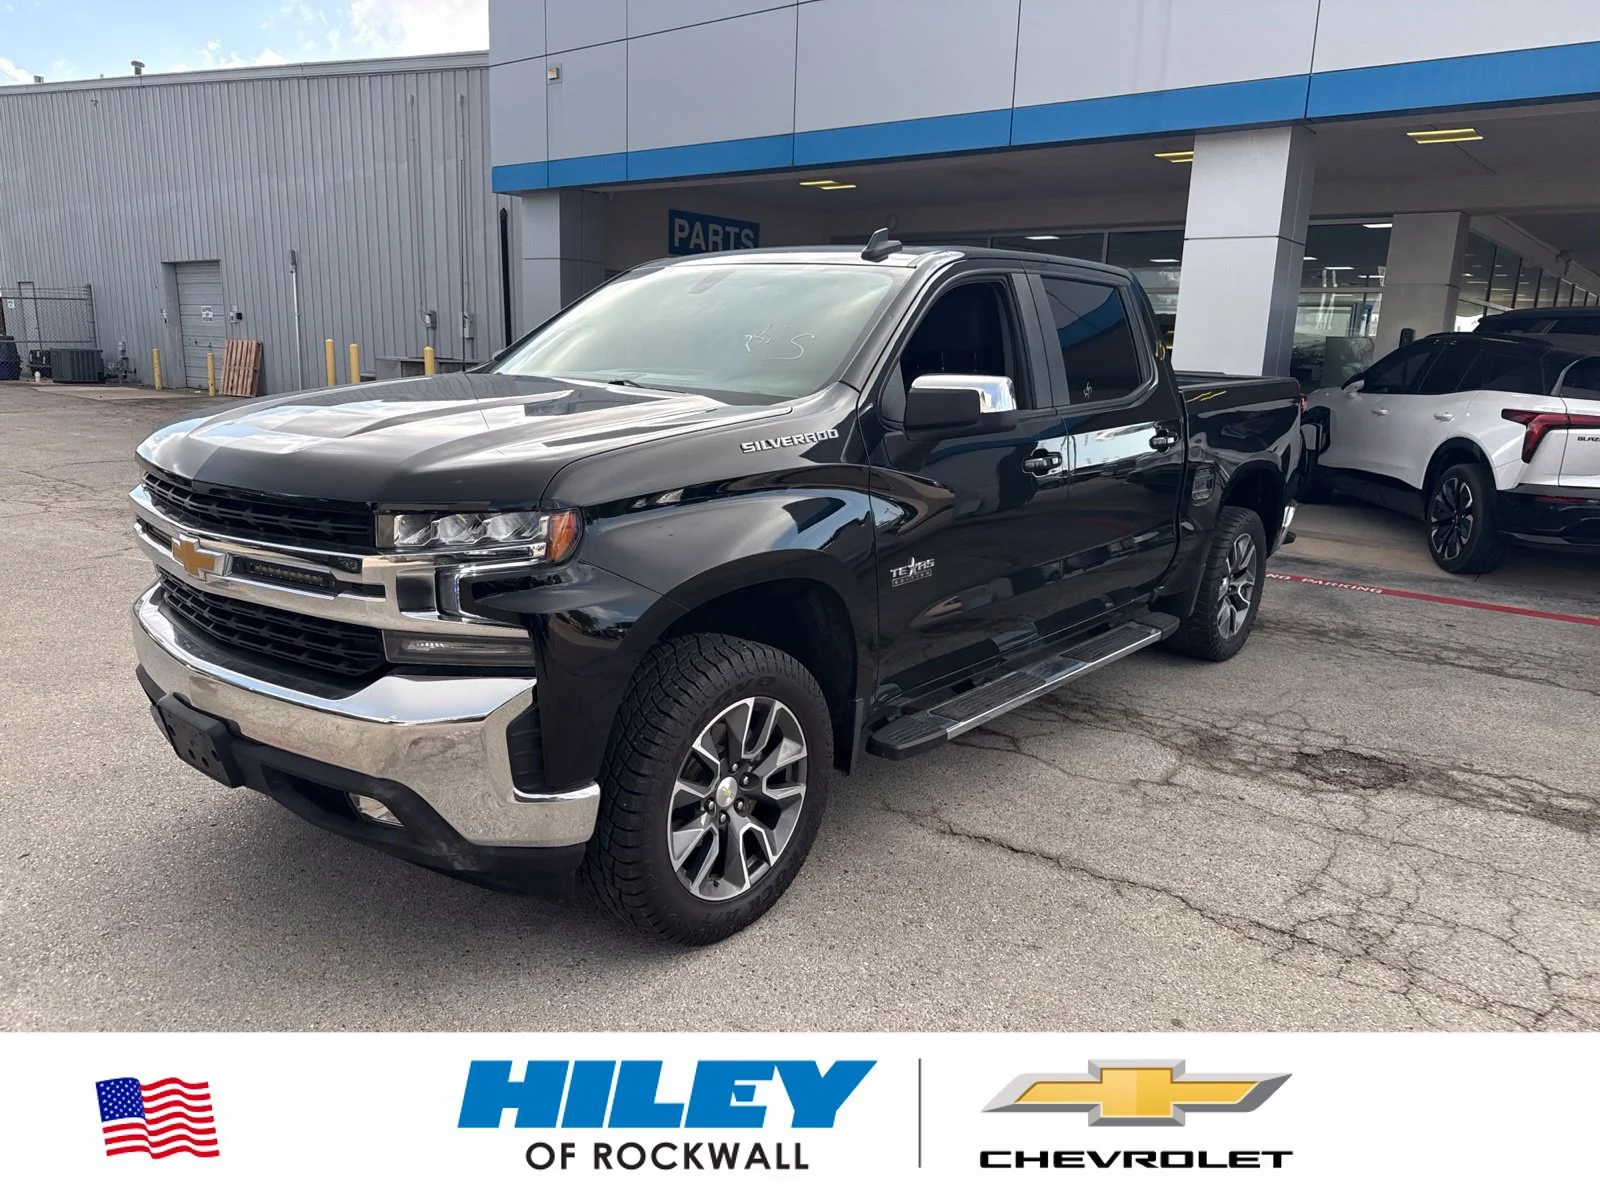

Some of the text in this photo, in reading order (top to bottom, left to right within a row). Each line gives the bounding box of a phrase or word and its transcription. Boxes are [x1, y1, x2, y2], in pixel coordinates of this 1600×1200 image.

[674, 217, 755, 252] PARTS
[740, 428, 839, 453] SILVERADO
[889, 557, 935, 578] TEXAS
[1301, 578, 1383, 593] PARKING
